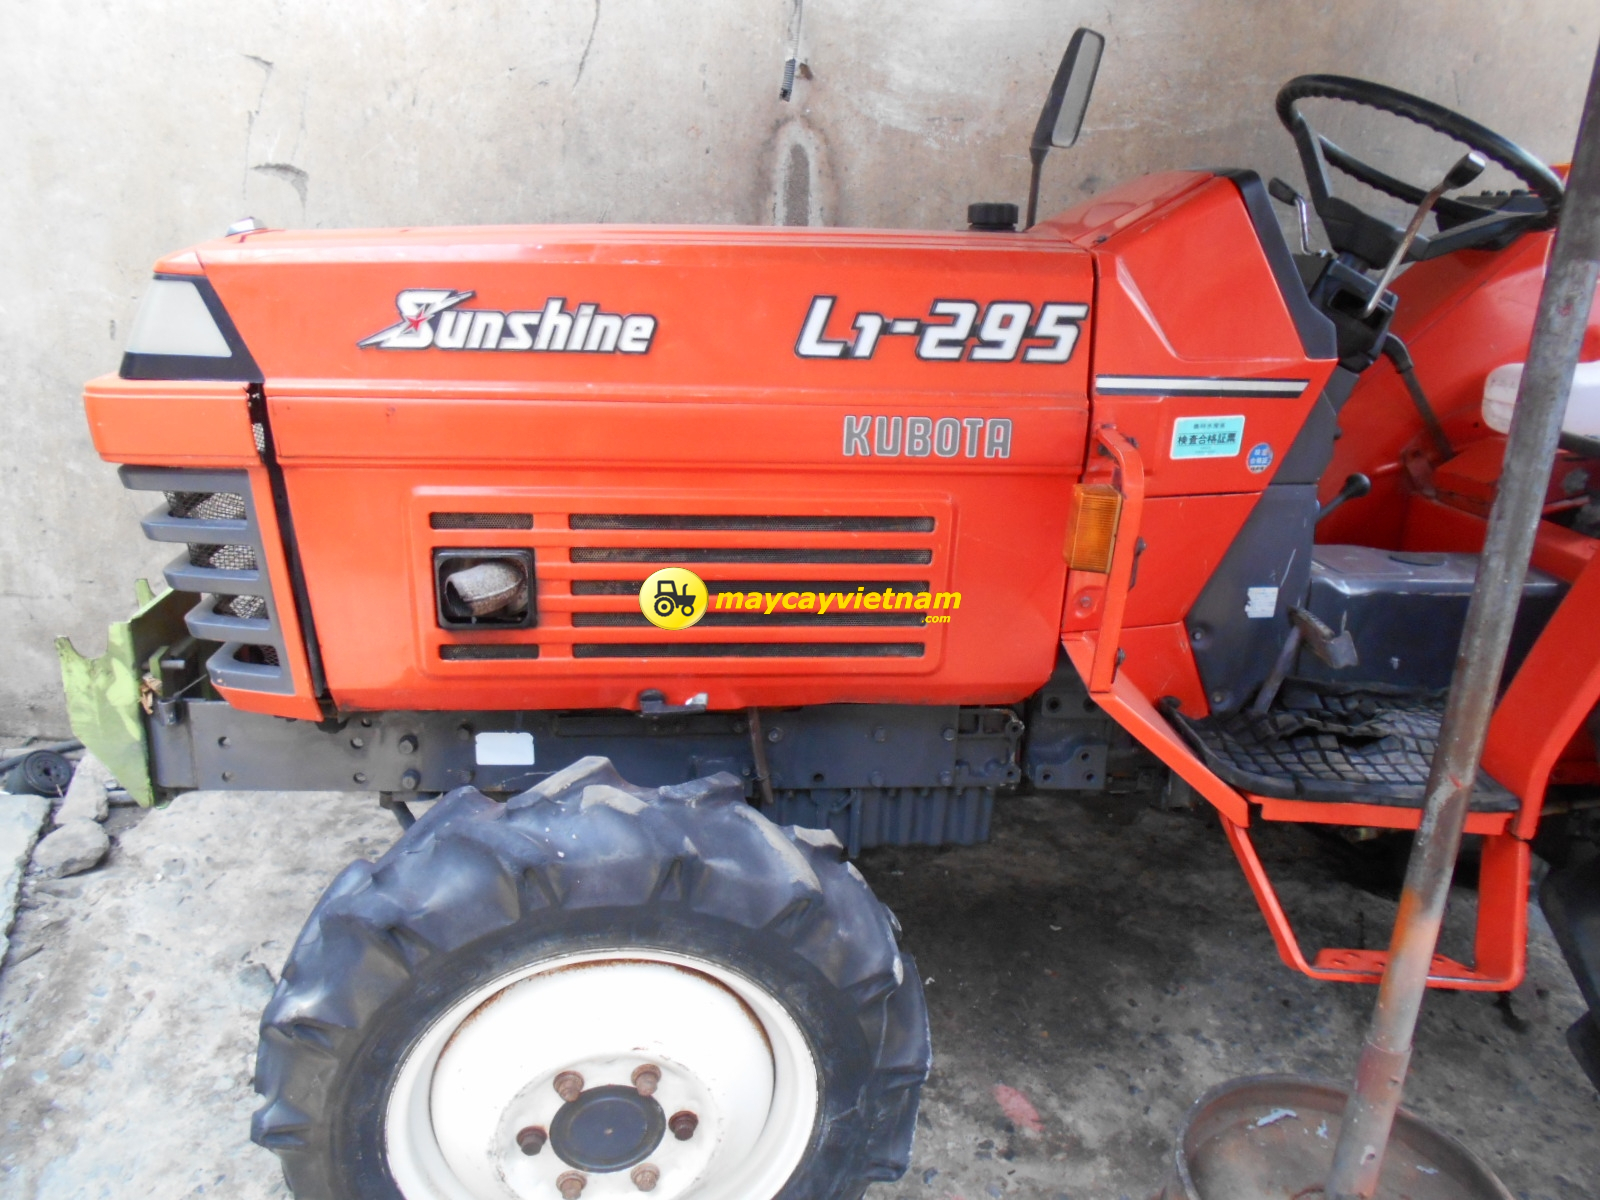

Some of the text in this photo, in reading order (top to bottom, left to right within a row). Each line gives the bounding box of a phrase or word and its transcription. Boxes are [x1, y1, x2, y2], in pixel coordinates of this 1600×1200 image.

[357, 288, 657, 355] Sunshine
[794, 295, 1089, 363] L1-295
[842, 415, 1012, 458] KUBOTA
